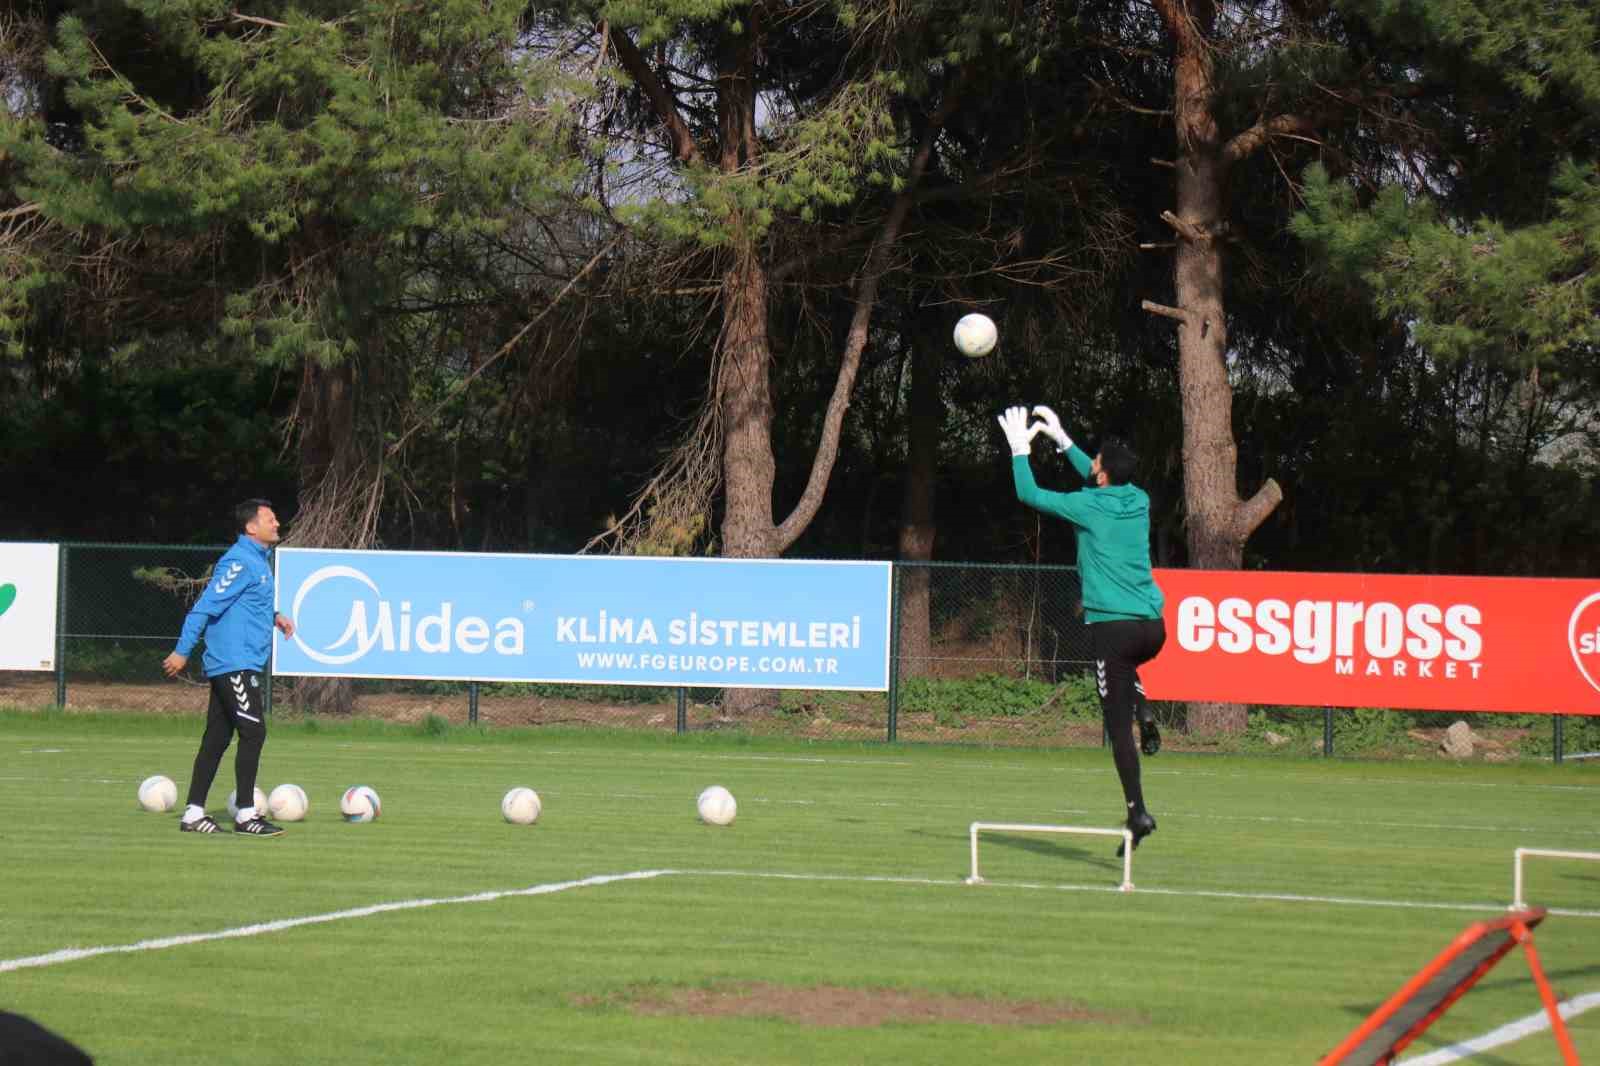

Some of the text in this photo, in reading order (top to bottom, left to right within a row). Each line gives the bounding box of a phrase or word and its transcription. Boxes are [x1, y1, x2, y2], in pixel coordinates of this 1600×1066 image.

[323, 600, 524, 656] Midea
[556, 609, 861, 649] KLİMA SİSTEMLERİ
[1176, 596, 1483, 665] essgross
[577, 652, 838, 674] WWW.FGEUROPE.COM.TR
[1335, 657, 1483, 679] MARKET
